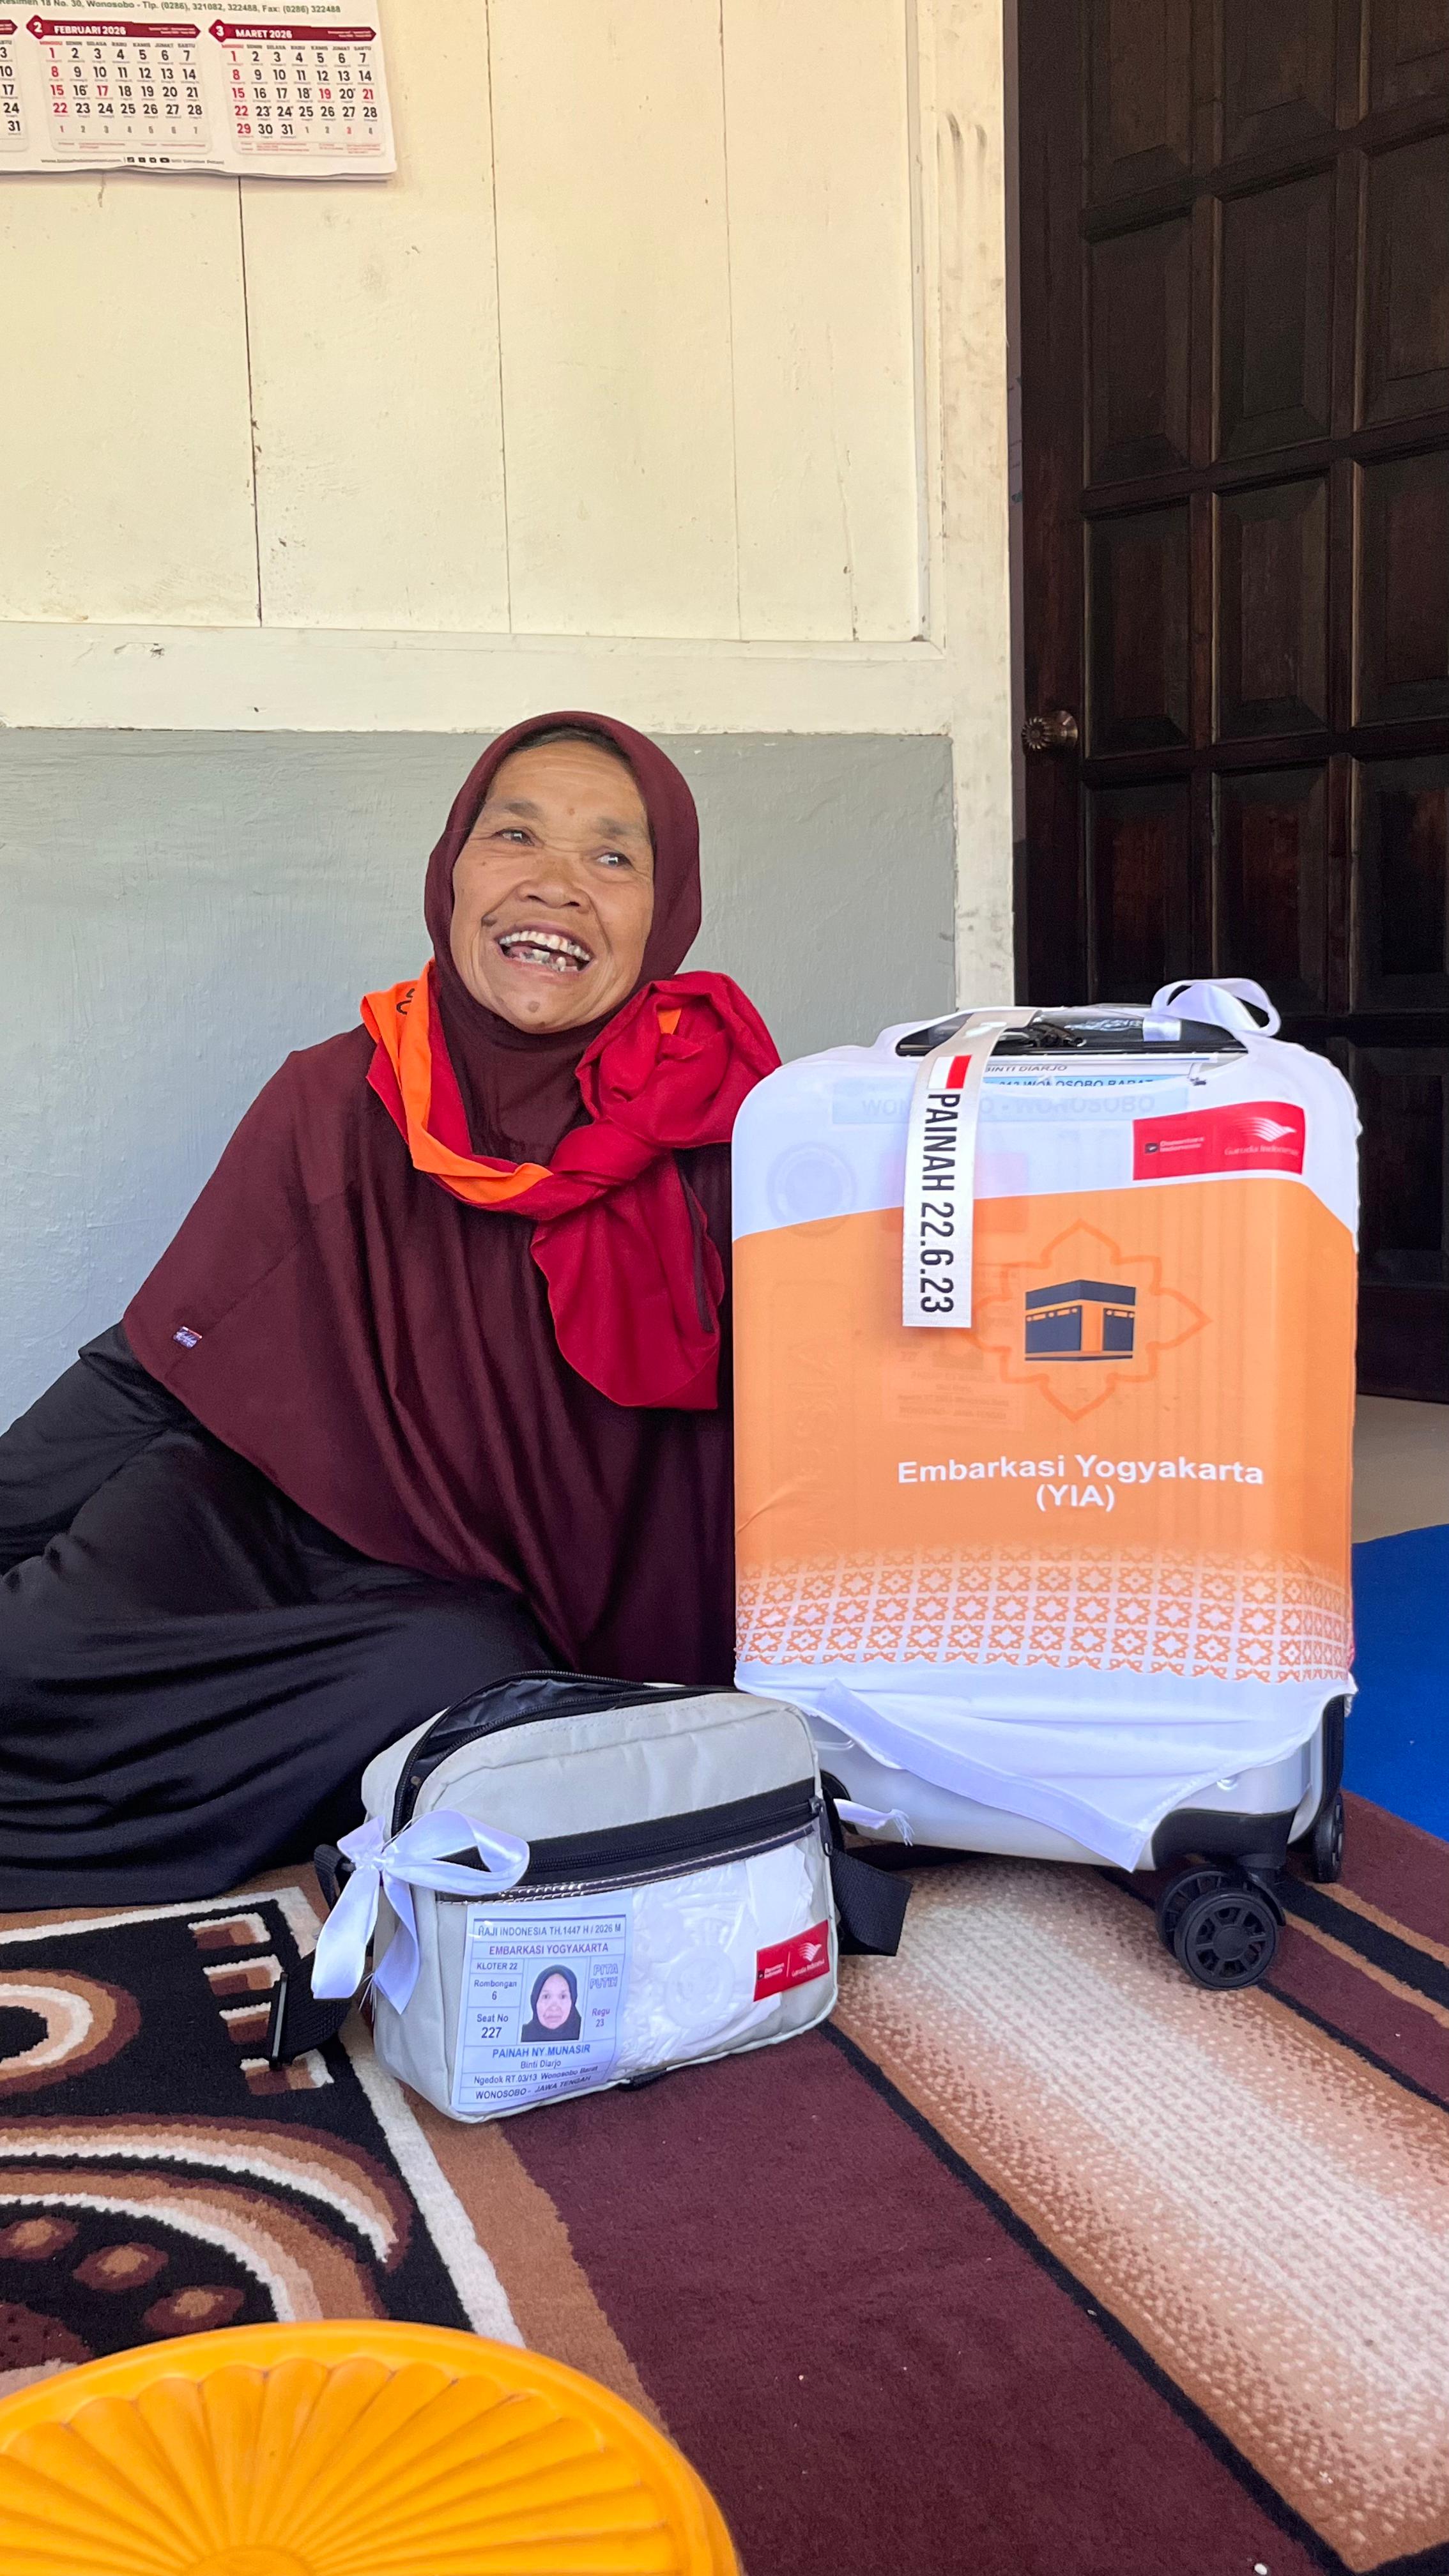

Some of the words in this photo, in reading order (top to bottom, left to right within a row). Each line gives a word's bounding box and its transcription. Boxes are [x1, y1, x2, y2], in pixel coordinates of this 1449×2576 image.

[33, 22, 43, 33] 2
[54, 26, 101, 34] FEBRUARI
[215, 26, 224, 36] 3
[235, 29, 268, 38] MARET
[50, 48, 54, 58] 1
[72, 48, 79, 58] 2
[95, 48, 101, 59] 3
[117, 49, 124, 59] 4
[139, 50, 146, 59] 5
[162, 50, 169, 61] 6
[183, 50, 190, 61] 7
[231, 51, 236, 61] 1
[252, 51, 259, 61] 2
[274, 52, 280, 62] 3
[296, 52, 302, 62] 4
[317, 52, 324, 63] 5
[339, 53, 345, 63] 6
[360, 53, 365, 63] 7
[52, 66, 58, 77] 8
[74, 66, 81, 77] 9
[94, 66, 106, 77] 10
[118, 67, 127, 77] 11
[139, 68, 151, 78] 12
[161, 68, 173, 79] 13
[183, 69, 195, 79] 14
[233, 70, 240, 80] 8
[255, 70, 261, 80] 9
[273, 70, 286, 80] 10
[296, 70, 305, 80] 11
[317, 71, 328, 80] 12
[338, 71, 349, 81] 13
[359, 70, 371, 81] 14
[3, 84, 13, 95] 17
[50, 85, 64, 95] 15
[97, 86, 108, 96] 17
[119, 86, 132, 96] 18
[141, 86, 153, 96] 19
[163, 87, 177, 96] 20
[187, 87, 198, 97] 21
[233, 88, 245, 98] 15
[254, 88, 266, 98] 16
[277, 88, 287, 98] 17
[319, 89, 331, 99] 19
[363, 89, 373, 99] 21
[4, 103, 19, 113] 24
[53, 103, 67, 112] 22
[76, 103, 90, 113] 23
[98, 103, 113, 113] 24
[121, 103, 135, 114] 25
[143, 104, 158, 114] 26
[166, 104, 179, 114] 27
[188, 105, 202, 115] 28
[235, 105, 248, 116] 22
[299, 107, 313, 117] 25
[321, 107, 334, 116] 26
[342, 107, 355, 117] 27
[364, 107, 377, 118] 28
[8, 121, 20, 131] 31
[237, 123, 250, 134] 29
[258, 124, 272, 134] 30
[282, 124, 293, 134] 31
[922, 1094, 961, 1190] PAINAH
[920, 1202, 954, 1313] 22.6.23
[898, 1455, 1064, 1483] Embarkasi
[1074, 1454, 1264, 1485] Yogyakarta
[1036, 1483, 1115, 1512] (YIA)
[500, 1926, 547, 1936] INDONESIA
[583, 1924, 589, 1934] H
[595, 1924, 613, 1933] 2026
[615, 1923, 621, 1932] M
[489, 1945, 544, 1955] EMBARKASI
[547, 1943, 608, 1954] YOGYAKARTA
[510, 1962, 518, 1970] 22
[594, 1963, 618, 1976] PITA
[474, 1980, 517, 1989] Rombongan
[492, 1991, 497, 2000] 6
[477, 2014, 495, 2022] Seat
[497, 2014, 509, 2022] No
[592, 2008, 610, 2017] Regu
[595, 2019, 604, 2028] 23
[481, 2027, 502, 2039] 227
[493, 2048, 529, 2058] PAINAH
[521, 2060, 538, 2069] Binti
[474, 2076, 503, 2086] Ngedok
[541, 2069, 578, 2080] Wonosobo
[579, 2066, 598, 2074] Barat
[475, 2088, 526, 2099] WONOSOBO
[535, 2083, 557, 2093] JAWA
[560, 2076, 591, 2087] TENGAH
